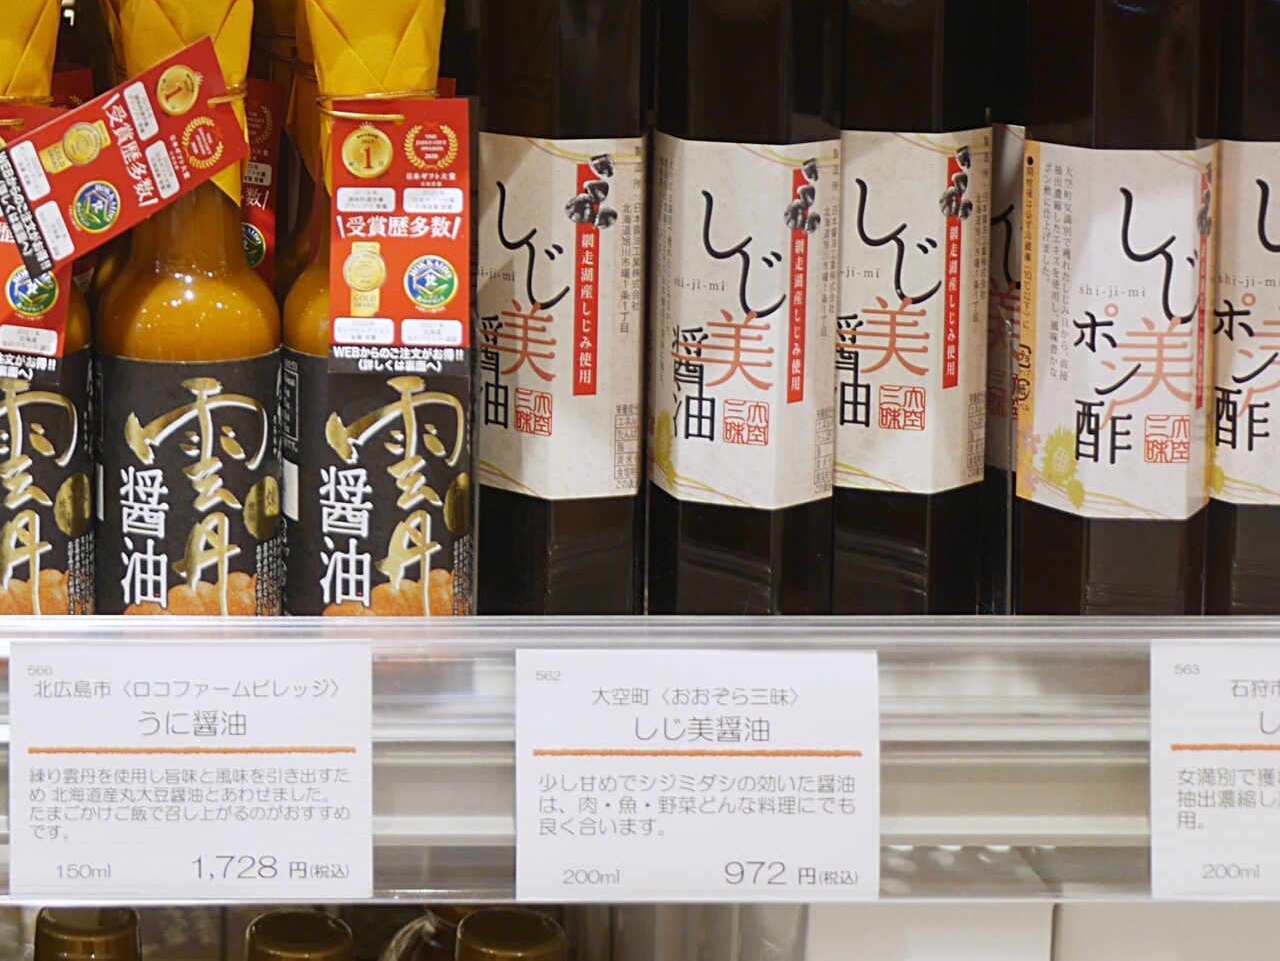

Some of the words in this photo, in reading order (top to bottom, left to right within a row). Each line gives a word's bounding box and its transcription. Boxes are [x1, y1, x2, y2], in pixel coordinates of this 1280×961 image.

[579, 232, 594, 385] 網走湖産しじみ使用
[120, 466, 169, 608] 醤油
[319, 465, 373, 608] 醤油
[27, 666, 53, 676] 566
[535, 670, 562, 681] 562
[1174, 664, 1200, 675] 563
[138, 710, 247, 737] うに醤油
[634, 716, 770, 742] しじ美醤油
[538, 818, 666, 837] 良く合います。
[1177, 811, 1205, 830] 用。
[33, 823, 70, 840] です。
[56, 864, 111, 879] 150ml
[191, 855, 278, 881] 1,728
[562, 869, 620, 885] 200ml
[724, 861, 787, 885] 972
[1202, 864, 1260, 879] 200ml
